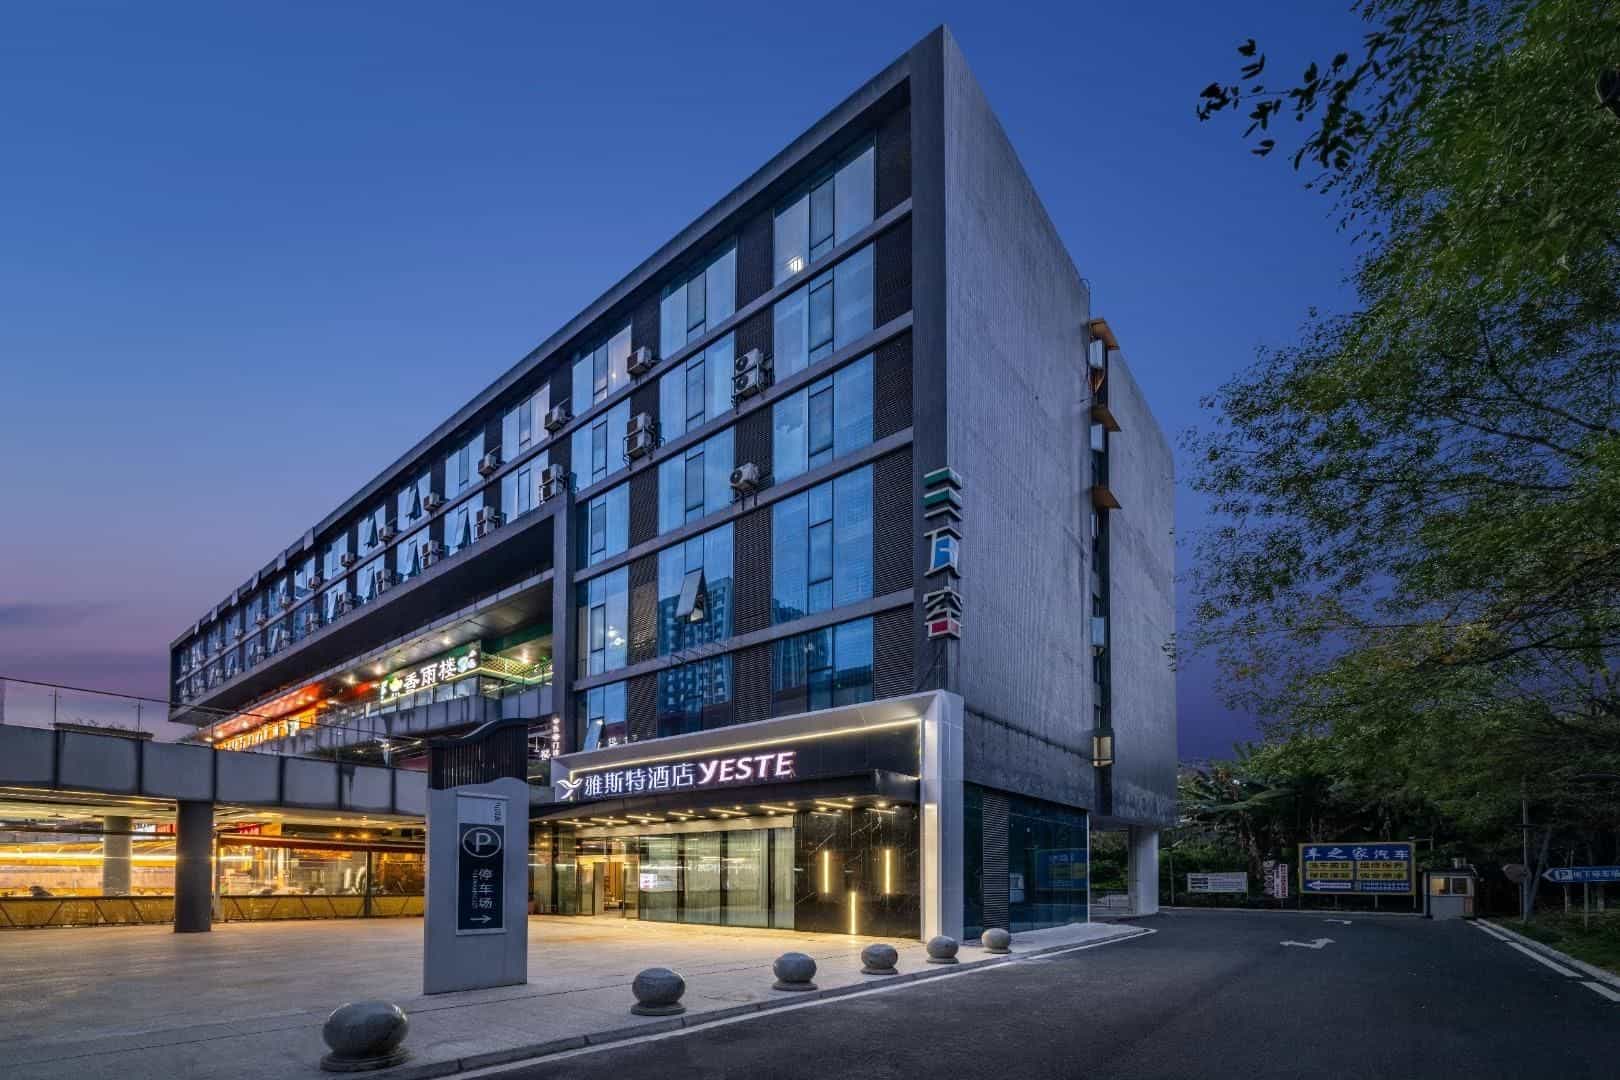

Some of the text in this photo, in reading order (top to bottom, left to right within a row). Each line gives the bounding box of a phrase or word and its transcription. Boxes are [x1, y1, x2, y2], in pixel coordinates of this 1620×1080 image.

[403, 657, 457, 690] 香雨楼
[584, 751, 795, 796] 雅斯特酒店 YESTE
[475, 832, 491, 853] P
[478, 867, 494, 909] 停车场
